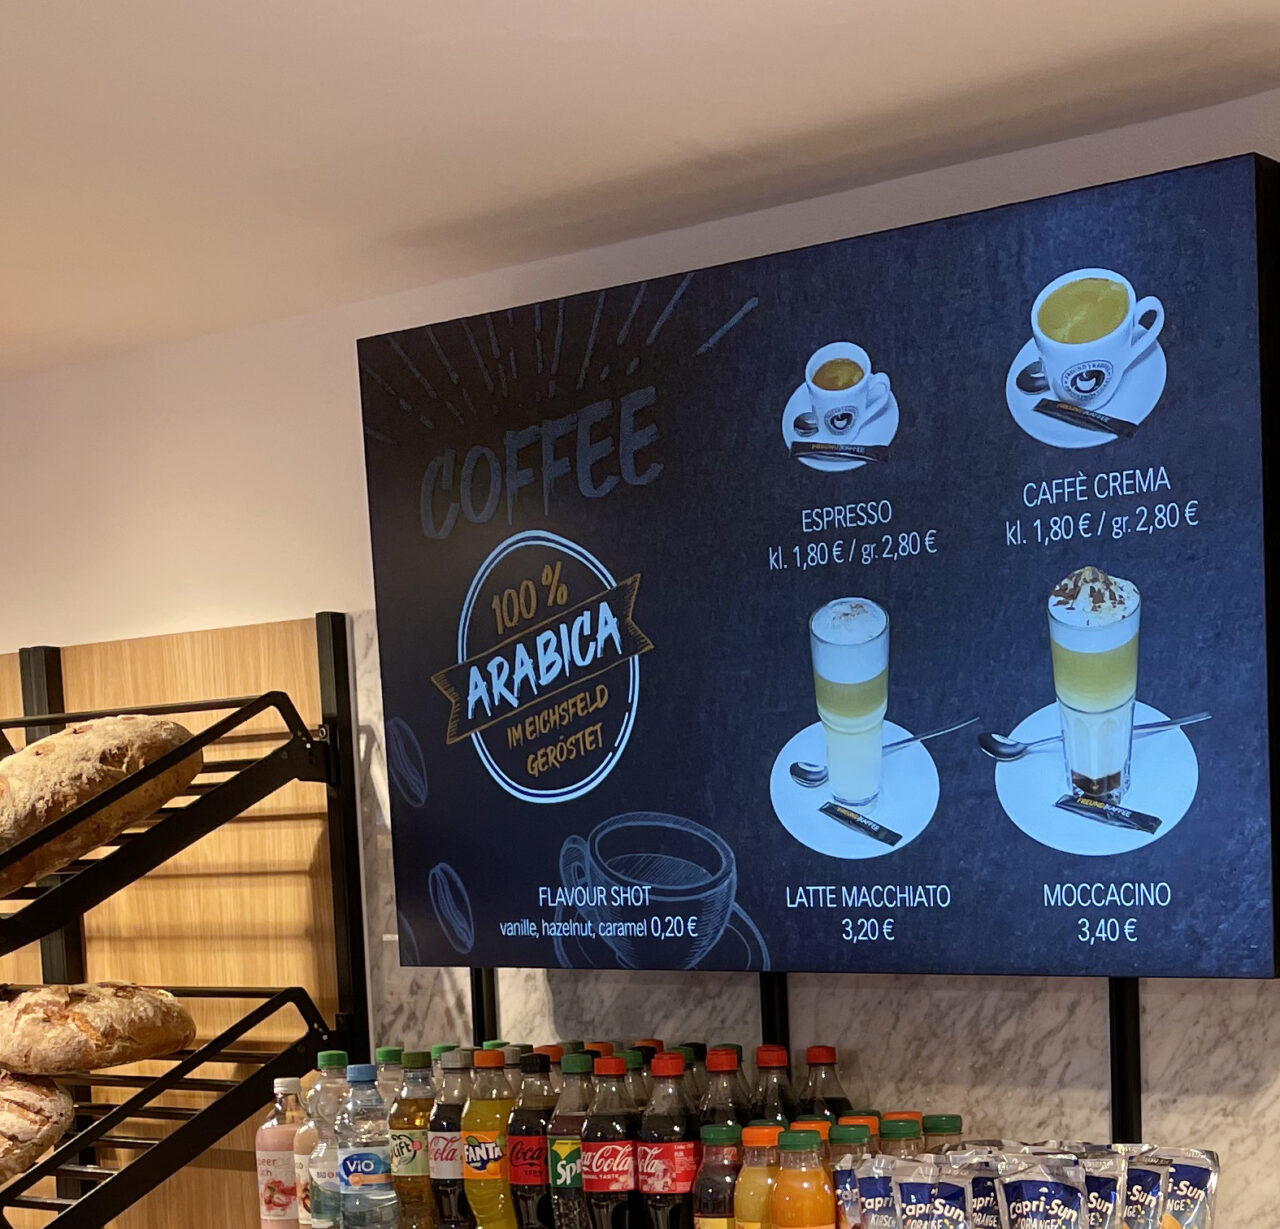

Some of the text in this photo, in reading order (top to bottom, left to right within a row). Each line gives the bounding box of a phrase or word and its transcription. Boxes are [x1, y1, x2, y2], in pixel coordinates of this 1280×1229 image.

[420, 386, 664, 540] COFFEE
[1023, 466, 1171, 508] CAFFÈ CREMA
[802, 500, 892, 533] ESPRESSO
[1005, 500, 1199, 546] kl. 1,80 € / gr. 2,80 €
[769, 529, 938, 570] kl. 1,80 € / gr. 2,80 €
[492, 561, 568, 635] 100 %
[467, 601, 622, 719] ARABICA
[507, 684, 609, 749] IM EICHSFELD
[526, 723, 603, 777] GERÖSTET
[538, 885, 652, 907] FLAVOUR SHOT
[786, 884, 951, 908] LATTE MACCHIATO
[1043, 882, 1171, 907] MOCCACINO
[500, 916, 698, 940] vanille, hazelnut, caramel 0,20 €
[842, 918, 895, 943] 3,20 €
[1077, 918, 1138, 943] 3,40 €
[464, 1142, 503, 1163] FANTA
[556, 1159, 582, 1185] Spr
[1009, 1196, 1078, 1222] Capri-Sun
